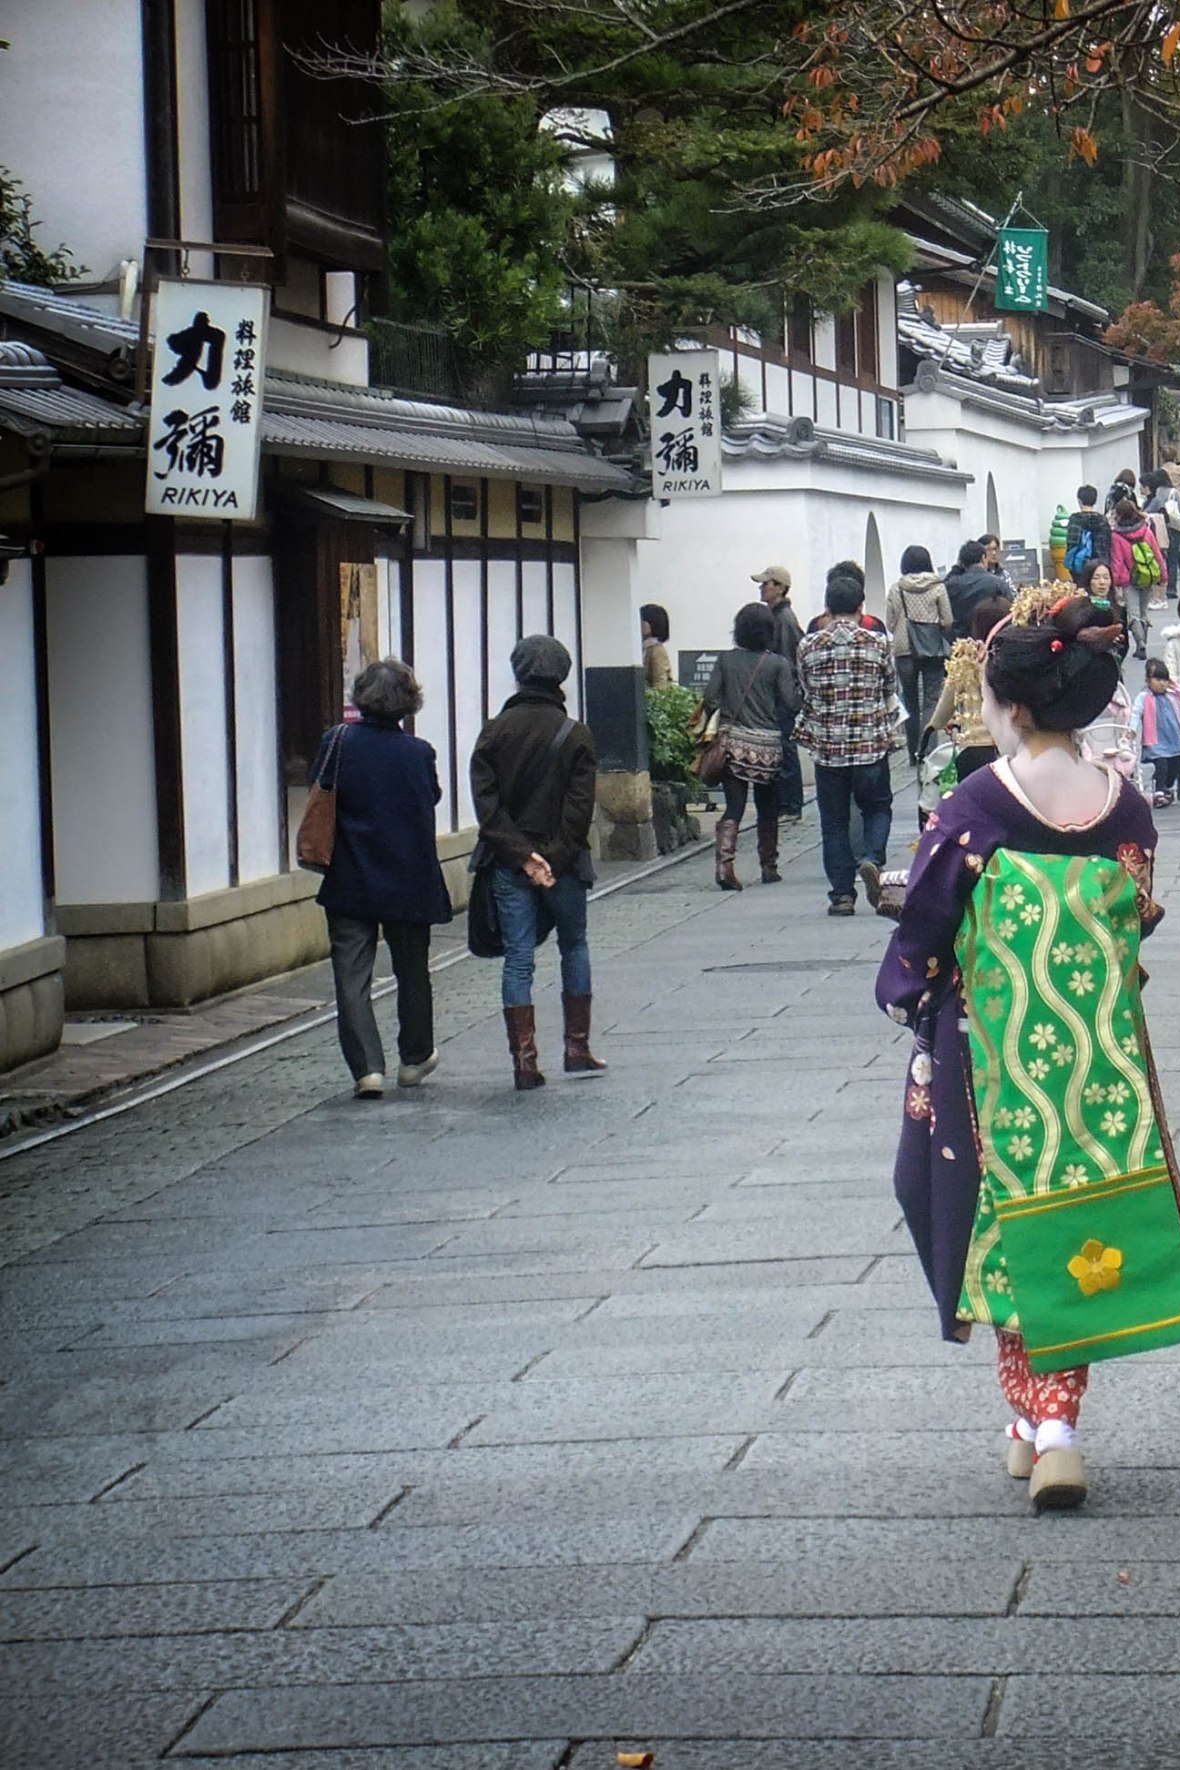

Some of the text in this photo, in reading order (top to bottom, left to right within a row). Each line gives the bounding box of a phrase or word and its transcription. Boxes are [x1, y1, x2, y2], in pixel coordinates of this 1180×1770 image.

[153, 311, 225, 479] 力彌
[230, 319, 257, 424] 料理旅館
[161, 487, 238, 509] RIKIYA
[662, 479, 711, 493] RIKIYA
